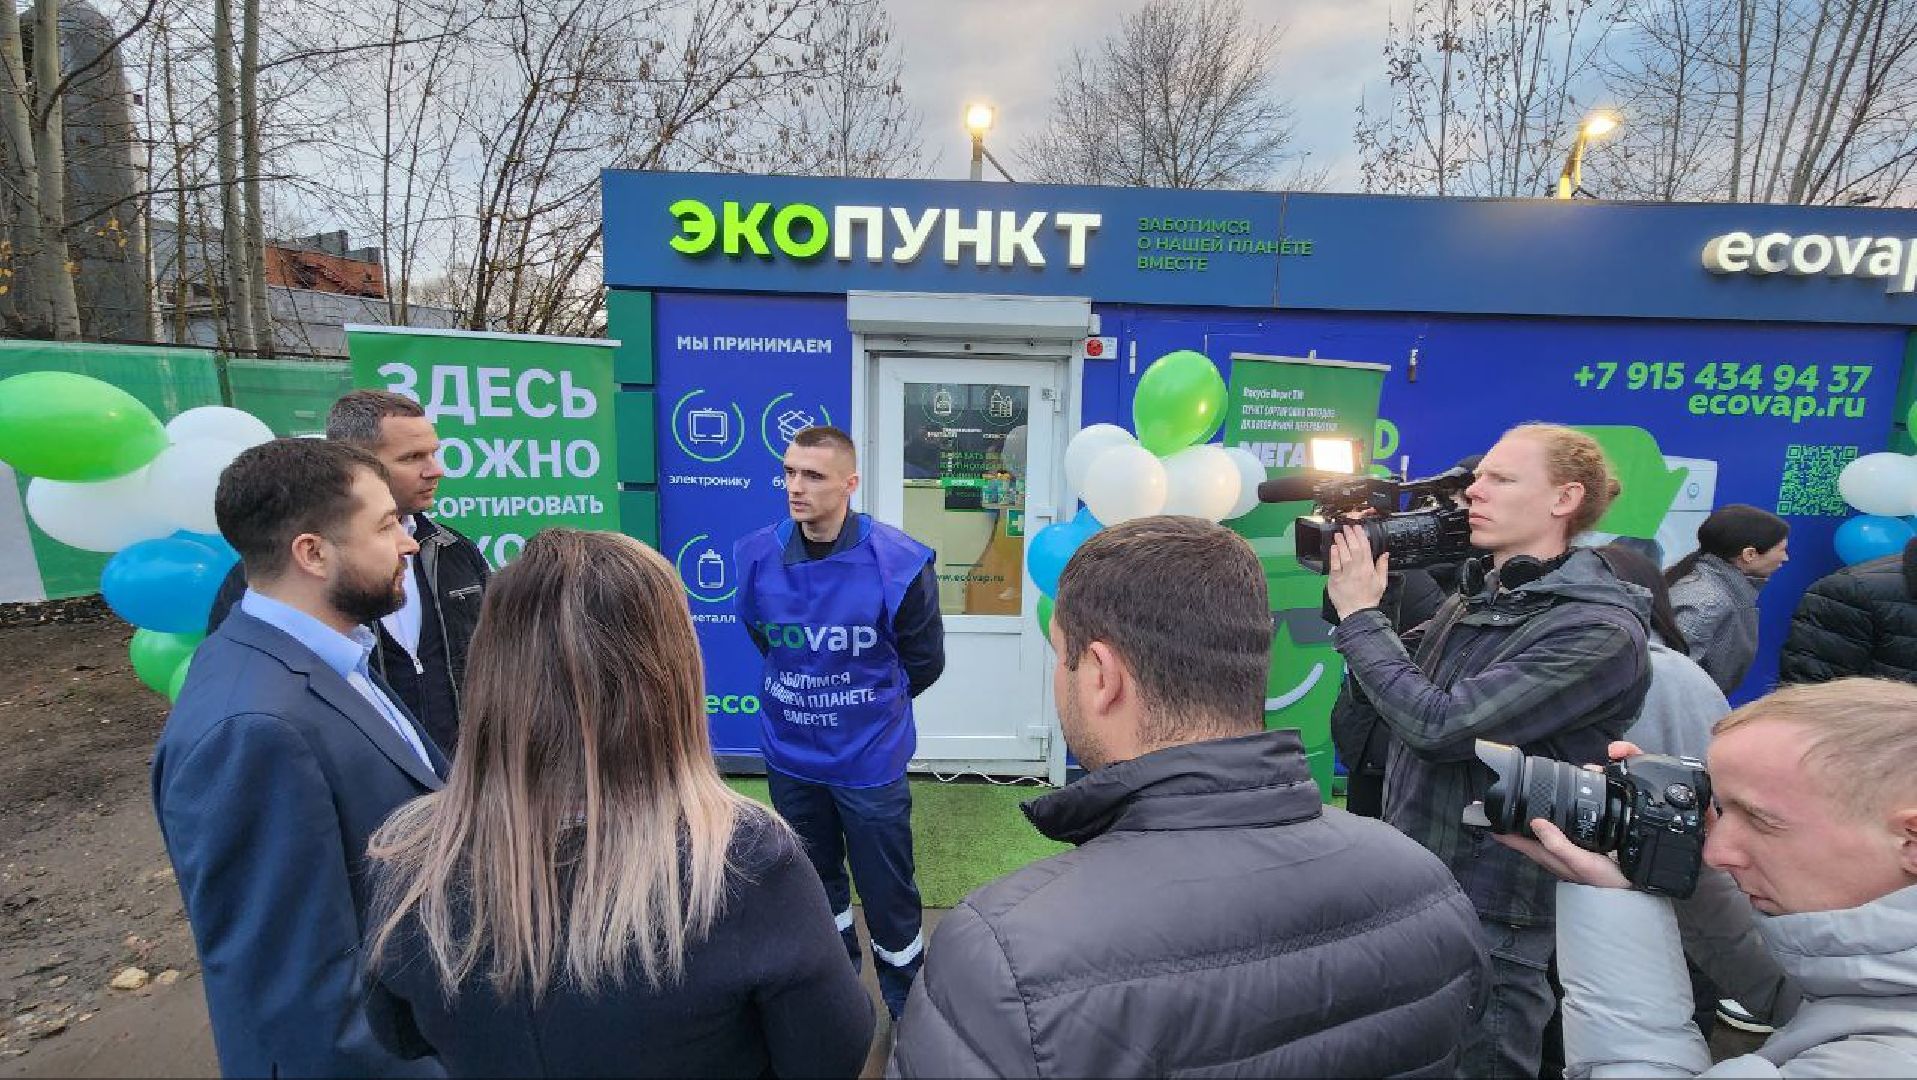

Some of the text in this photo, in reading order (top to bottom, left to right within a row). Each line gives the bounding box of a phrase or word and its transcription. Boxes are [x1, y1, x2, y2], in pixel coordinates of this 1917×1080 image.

[669, 200, 1102, 268] ЭКОПУНКТ
[1137, 217, 1252, 234] ЗАБОТИМСЯ
[1137, 235, 1314, 256] О НАШЕЙ ПЛАНЕТЕ
[1137, 256, 1209, 271] ВМЕСТЕ
[677, 335, 832, 353] МЫ ПРИНИМАЕМ
[1574, 361, 1873, 393] +7 915 434 94 37
[377, 362, 598, 425] ЗДЕСЬ
[1688, 394, 1866, 424] ecovap.ru
[437, 437, 601, 478] ОЖНО
[669, 475, 751, 489] электронику
[758, 621, 878, 657] covap
[779, 671, 851, 690] АБОТИМСЯ
[704, 694, 760, 714] eco
[808, 687, 877, 708] ПЛАНЕТЕ
